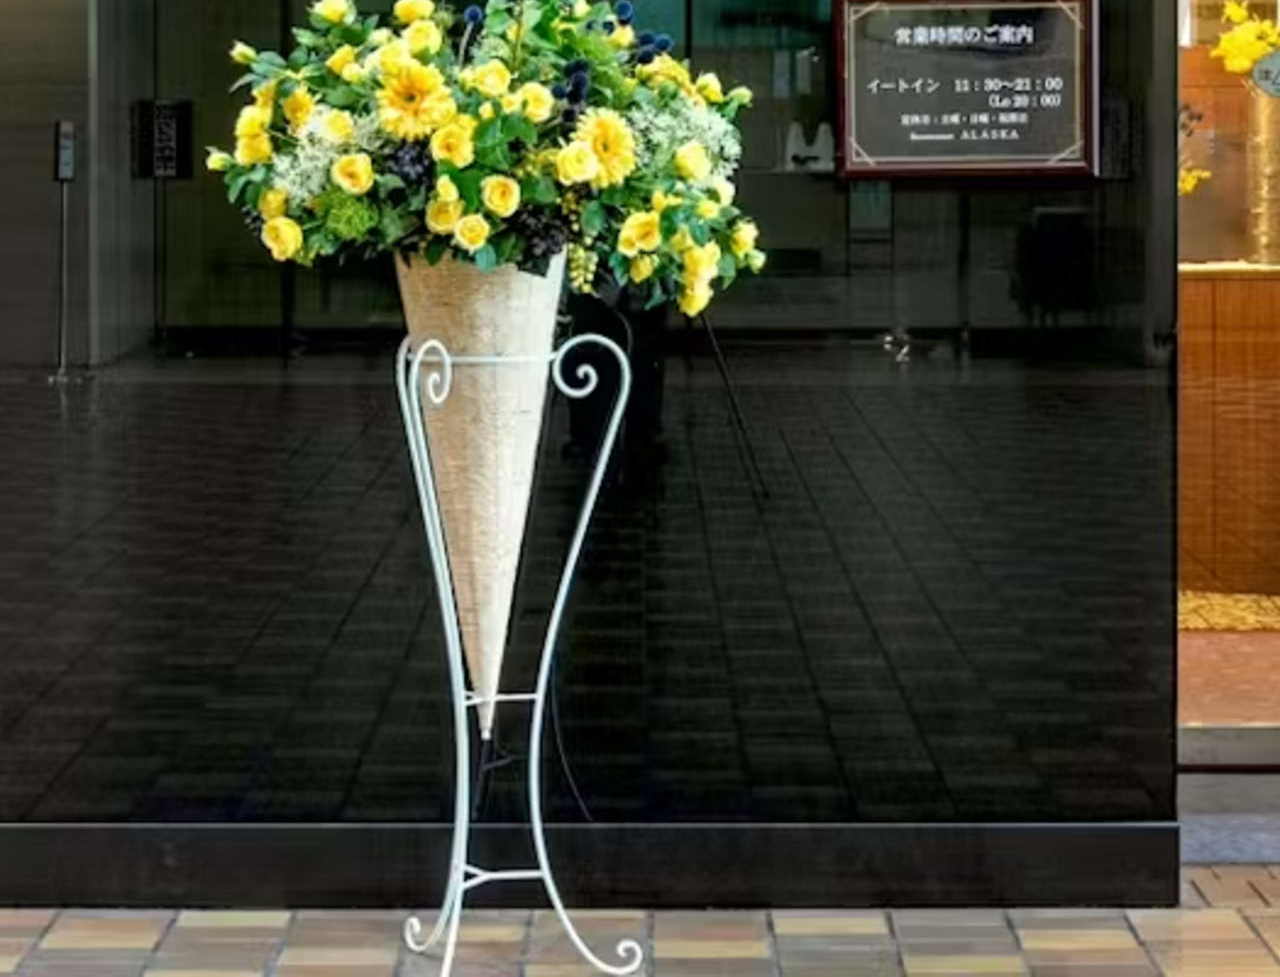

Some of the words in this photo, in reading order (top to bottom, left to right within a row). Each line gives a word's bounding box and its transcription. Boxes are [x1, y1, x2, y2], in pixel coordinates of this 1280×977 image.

[894, 24, 1035, 45] 営業時間のご案内
[867, 77, 941, 94] イートイン
